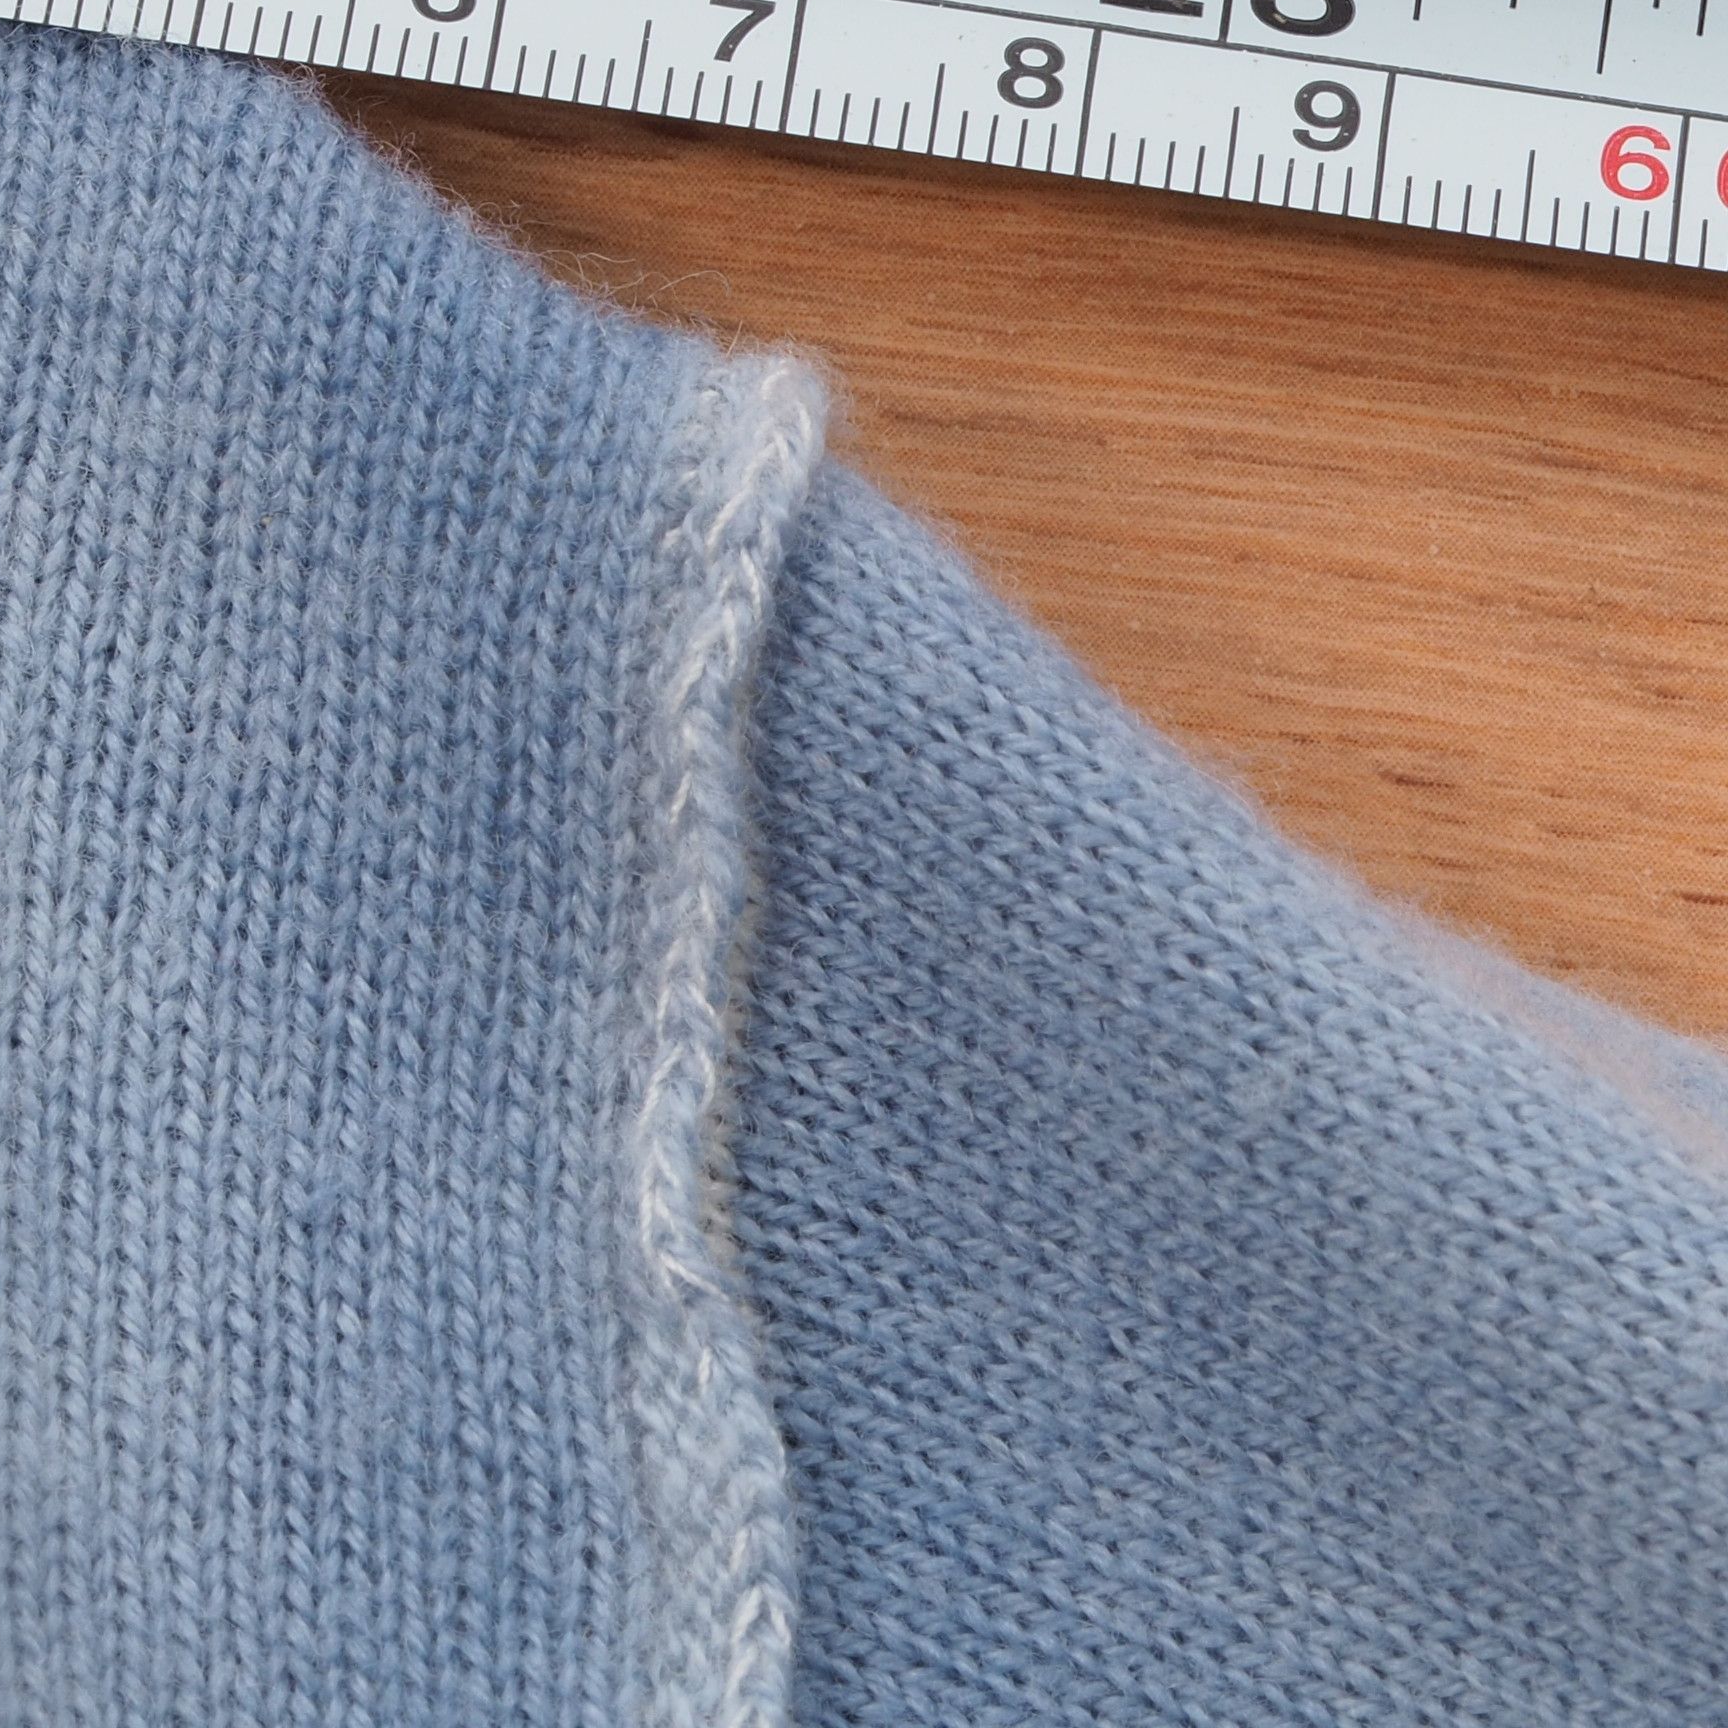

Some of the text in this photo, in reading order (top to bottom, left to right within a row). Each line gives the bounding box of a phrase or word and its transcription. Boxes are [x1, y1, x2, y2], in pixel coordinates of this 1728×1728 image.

[997, 37, 1065, 109] 8
[1293, 80, 1361, 152] 9
[1600, 126, 1728, 210] 6
